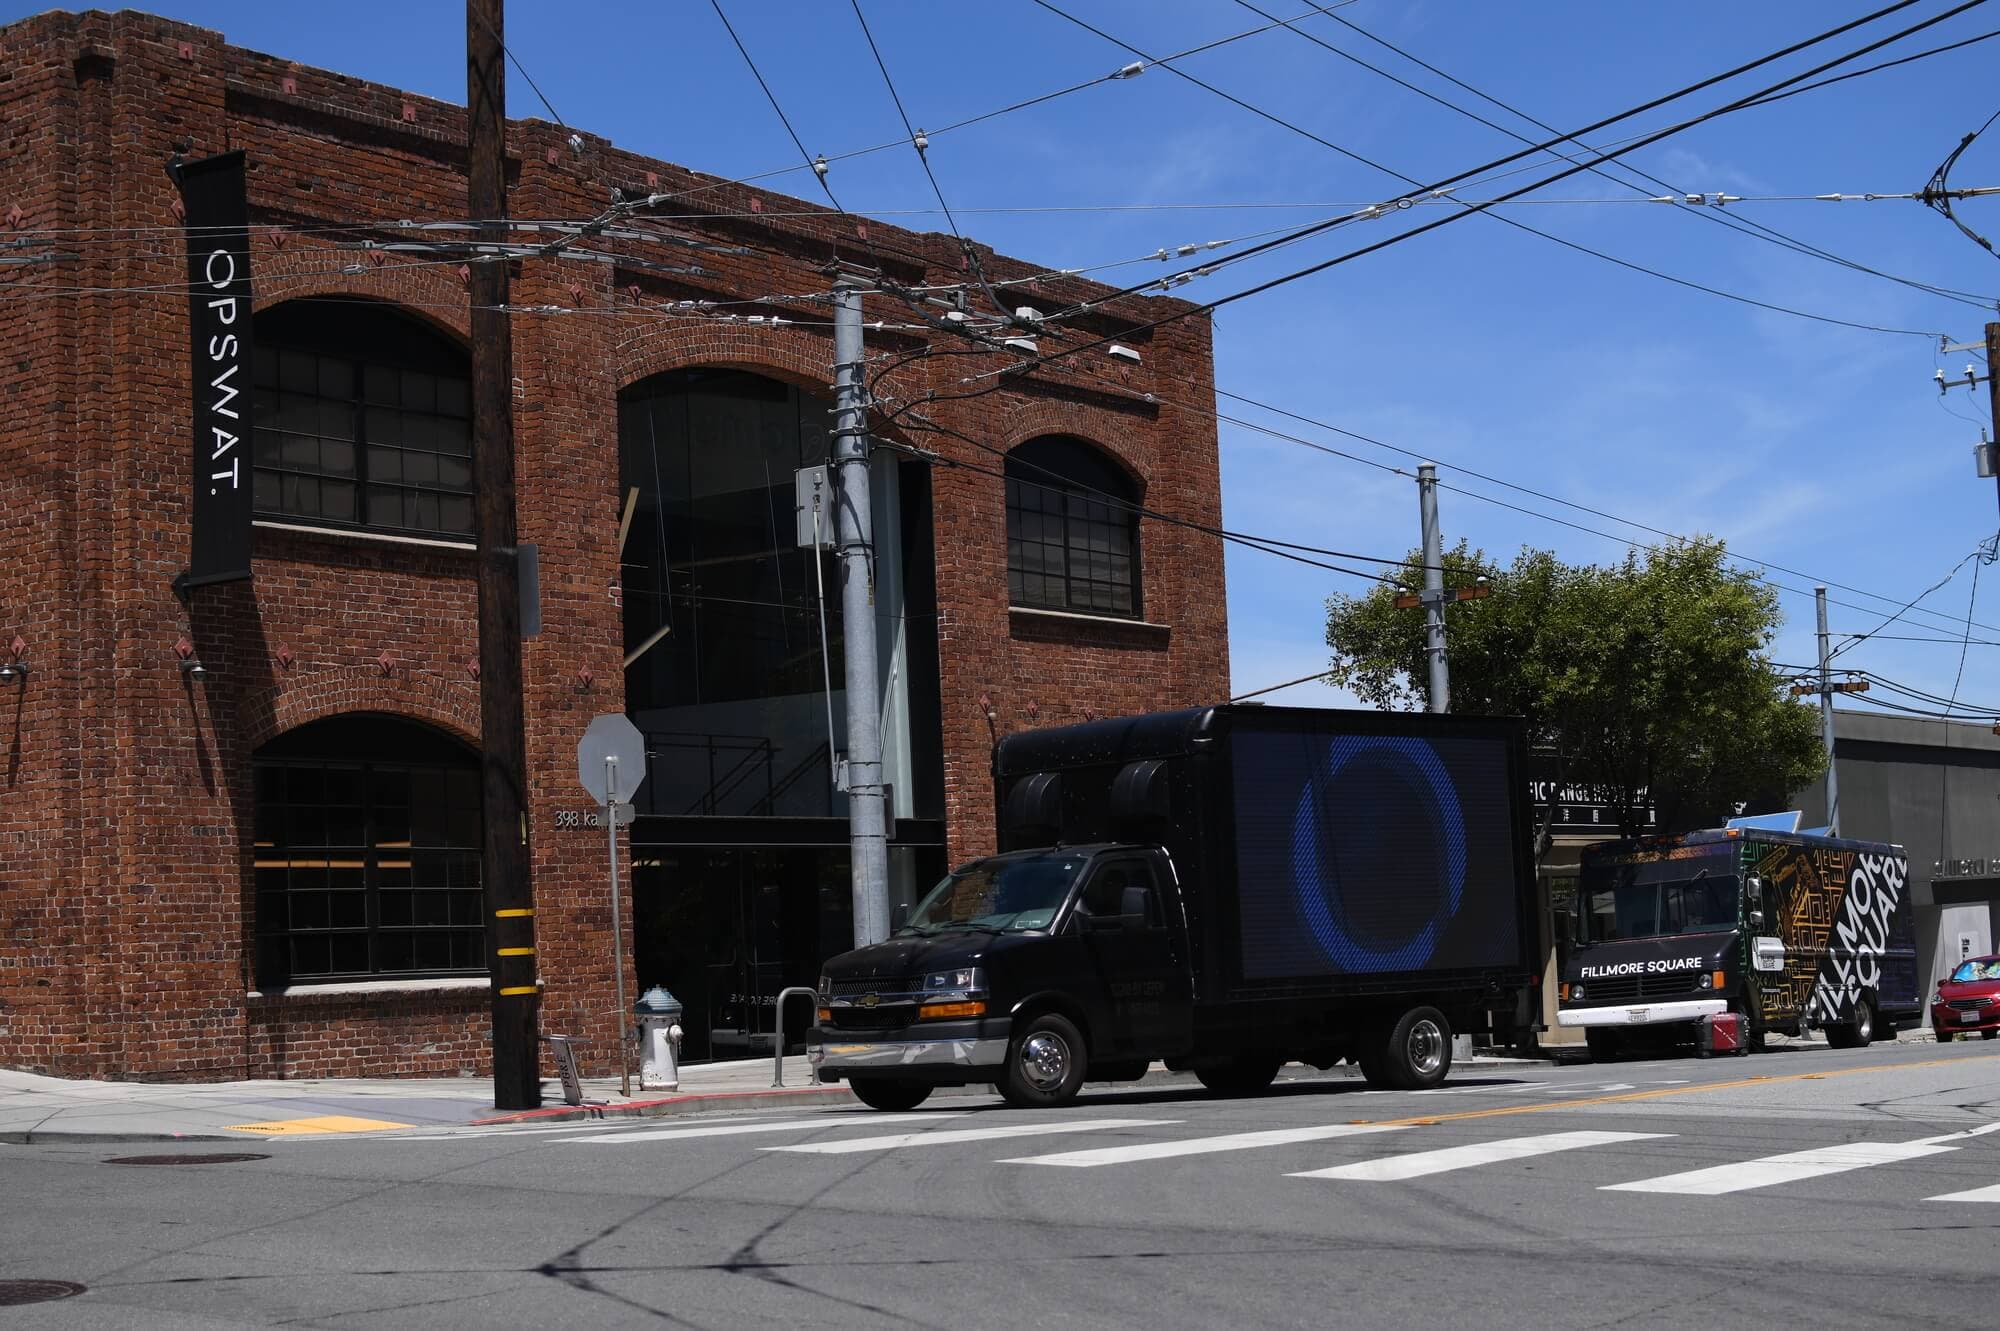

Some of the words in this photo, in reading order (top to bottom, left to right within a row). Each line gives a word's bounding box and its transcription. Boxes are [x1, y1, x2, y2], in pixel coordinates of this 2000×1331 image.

[205, 248, 240, 496] OPSWAT.
[554, 810, 579, 827] 398
[1581, 961, 1645, 978] FILLMORE
[1647, 957, 1703, 973] SQUARE
[557, 1055, 573, 1089] PG&E
